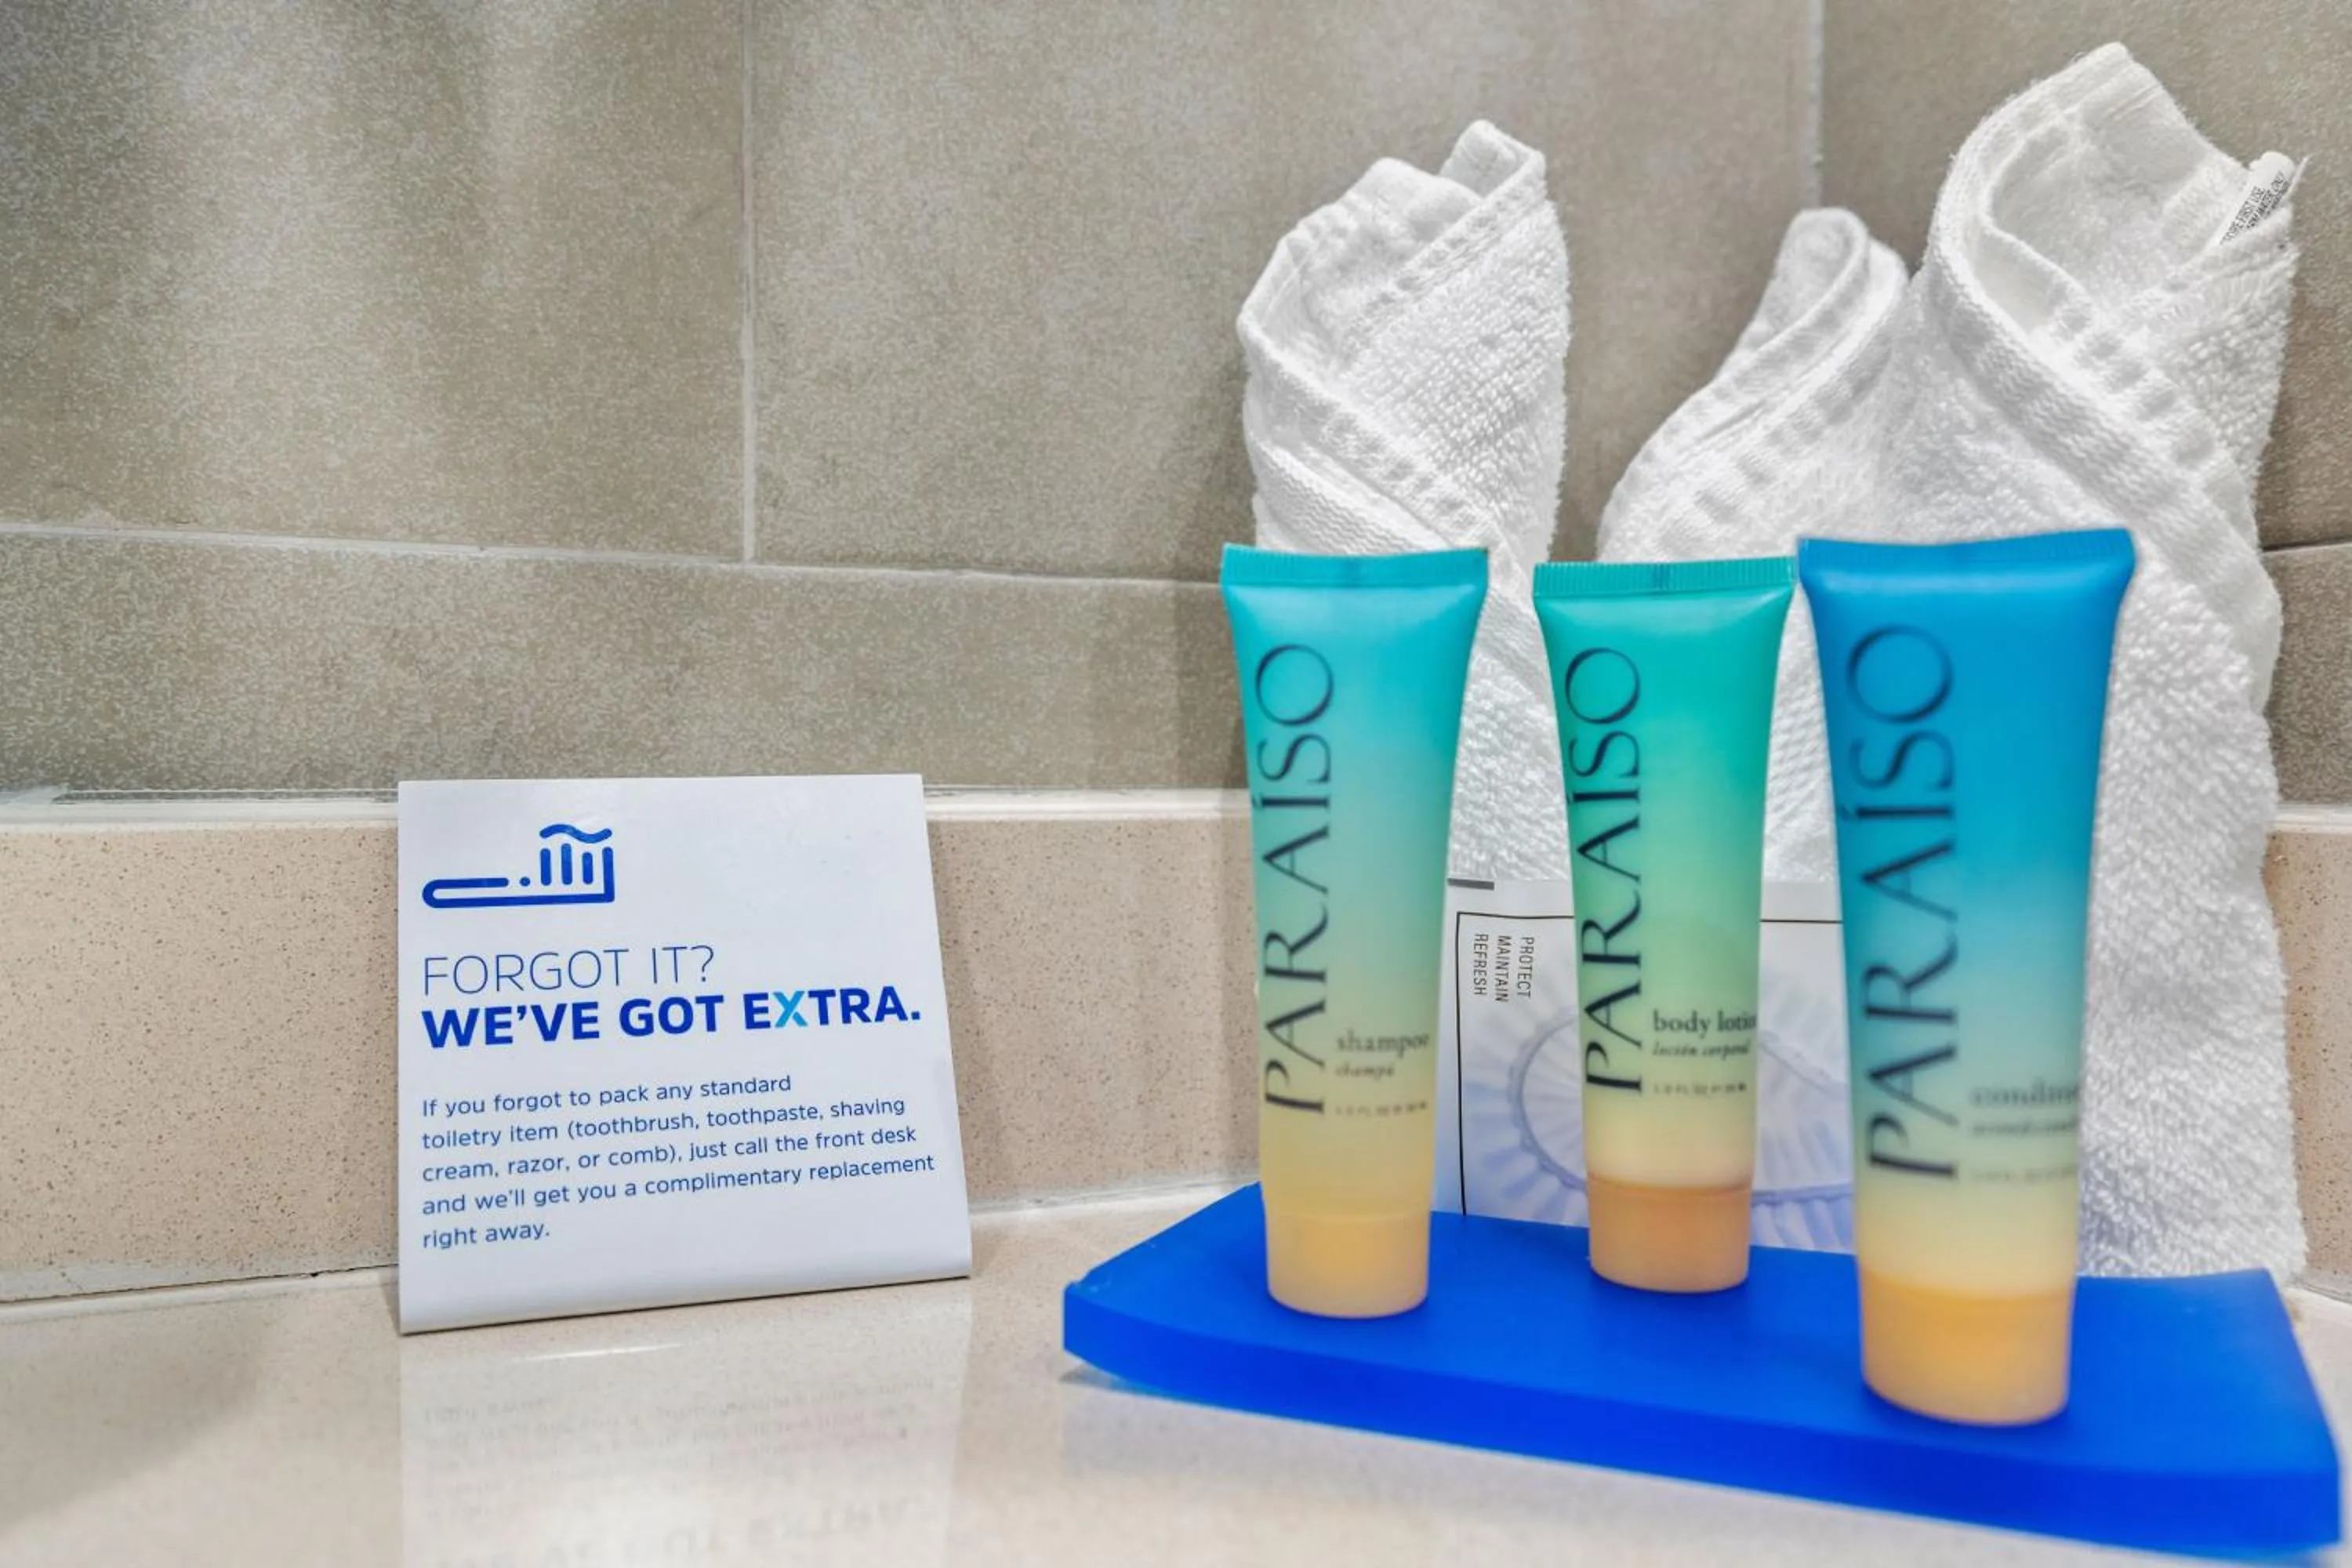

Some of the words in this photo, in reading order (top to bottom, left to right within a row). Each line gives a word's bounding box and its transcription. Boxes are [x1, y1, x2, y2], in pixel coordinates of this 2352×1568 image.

[1252, 644, 1334, 1115] PARAÍSO
[1565, 647, 1641, 1093] PARAÍSO
[1844, 624, 1957, 1179] PARAÍSO
[423, 948, 629, 995] FORGOT
[651, 946, 714, 983] IT?
[1473, 935, 1488, 996] REFRESH
[1495, 936, 1512, 1003] MAINTAIN
[1517, 938, 1534, 999] PROTECT
[618, 995, 724, 1036] GOT
[742, 985, 921, 1029] EXTRA.
[1652, 1009, 1712, 1040] body
[422, 1099, 436, 1117] If
[446, 1099, 485, 1118] you
[494, 1094, 561, 1113] forgot
[570, 1091, 590, 1105] to
[599, 1085, 648, 1105] pack
[656, 1082, 693, 1101] any
[700, 1076, 792, 1098] standard
[422, 1129, 501, 1149] toiletry
[510, 1125, 558, 1143] item
[568, 1112, 700, 1141] (toothbrush,
[707, 1105, 824, 1127] toothpaste,
[830, 1098, 906, 1119] shaving
[422, 1161, 499, 1182] cream,
[507, 1156, 570, 1175] razor,
[578, 1153, 602, 1169] or
[608, 1143, 682, 1168] comb),
[689, 1142, 728, 1161] just
[735, 1137, 768, 1156] call
[775, 1134, 809, 1152] the
[815, 1132, 866, 1149] front
[871, 1126, 916, 1145] desk
[422, 1195, 466, 1215] and
[475, 1189, 524, 1210] we'll
[534, 1185, 570, 1207] get
[577, 1183, 616, 1202] you
[624, 1182, 637, 1196] a
[644, 1167, 803, 1195] complimentary
[809, 1155, 936, 1181] replacement
[422, 1228, 477, 1250] right
[485, 1222, 550, 1243] away.
